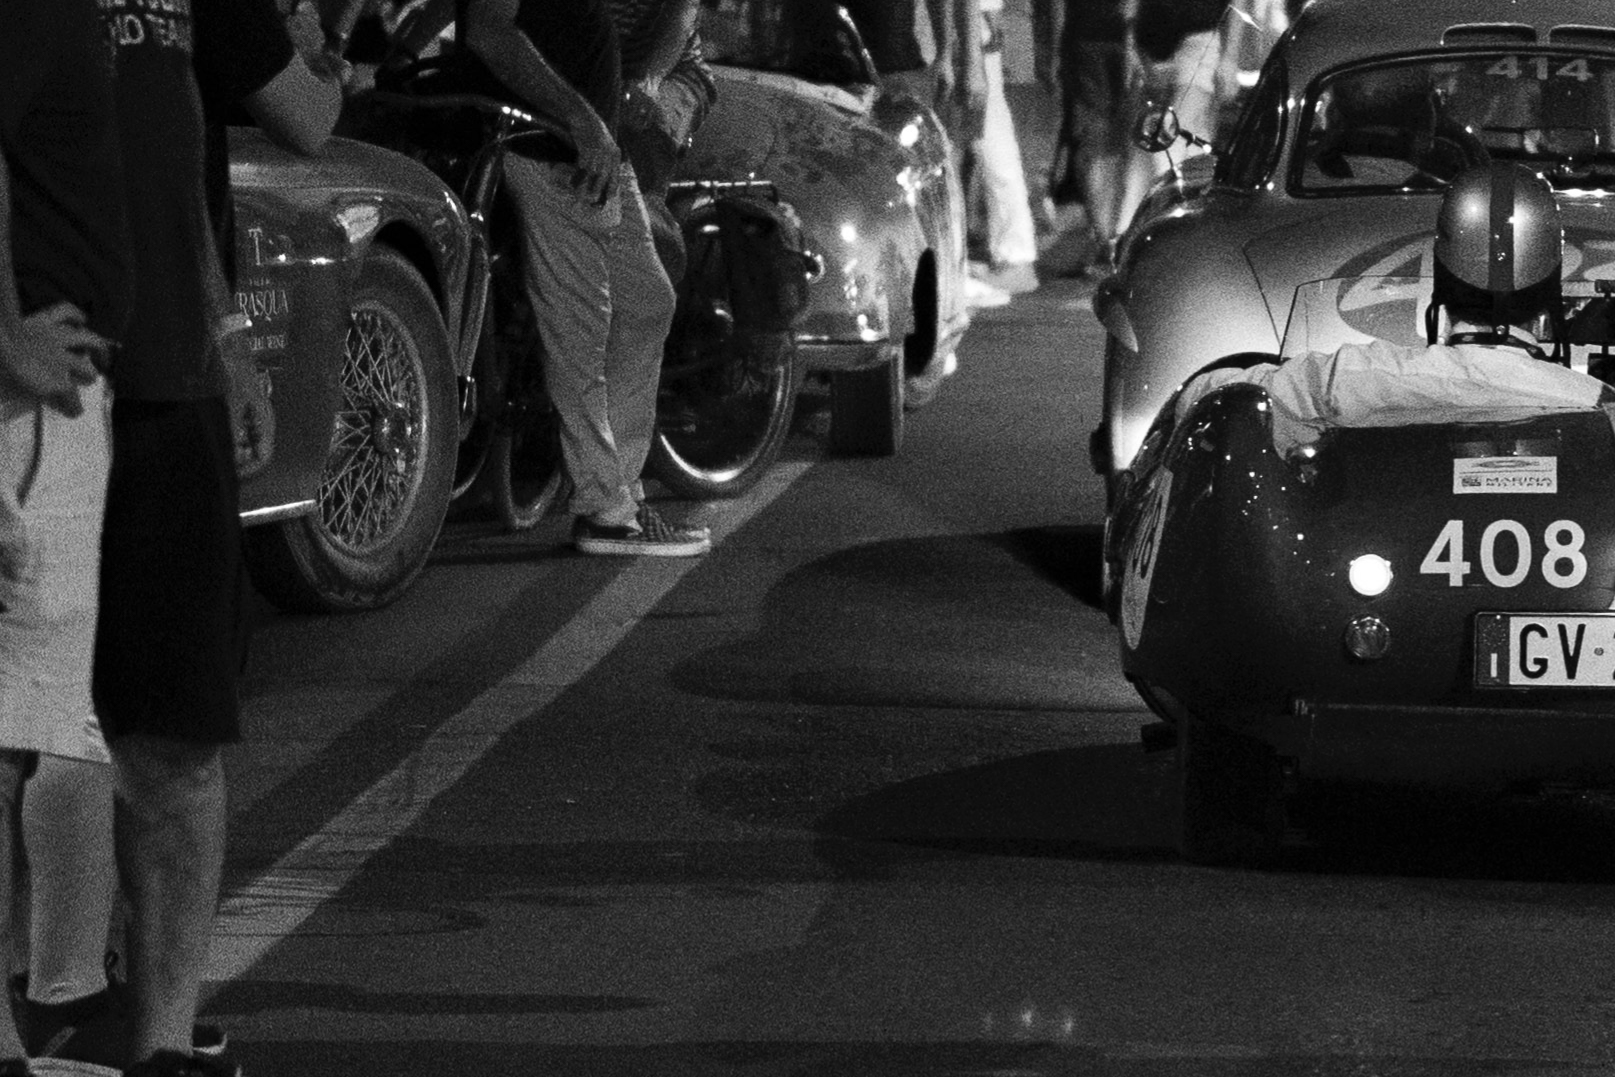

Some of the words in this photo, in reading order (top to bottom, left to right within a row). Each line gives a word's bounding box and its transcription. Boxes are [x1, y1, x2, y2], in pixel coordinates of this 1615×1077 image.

[1484, 55, 1594, 82] 414
[1419, 519, 1588, 589] 408
[1518, 623, 1587, 681] GV
